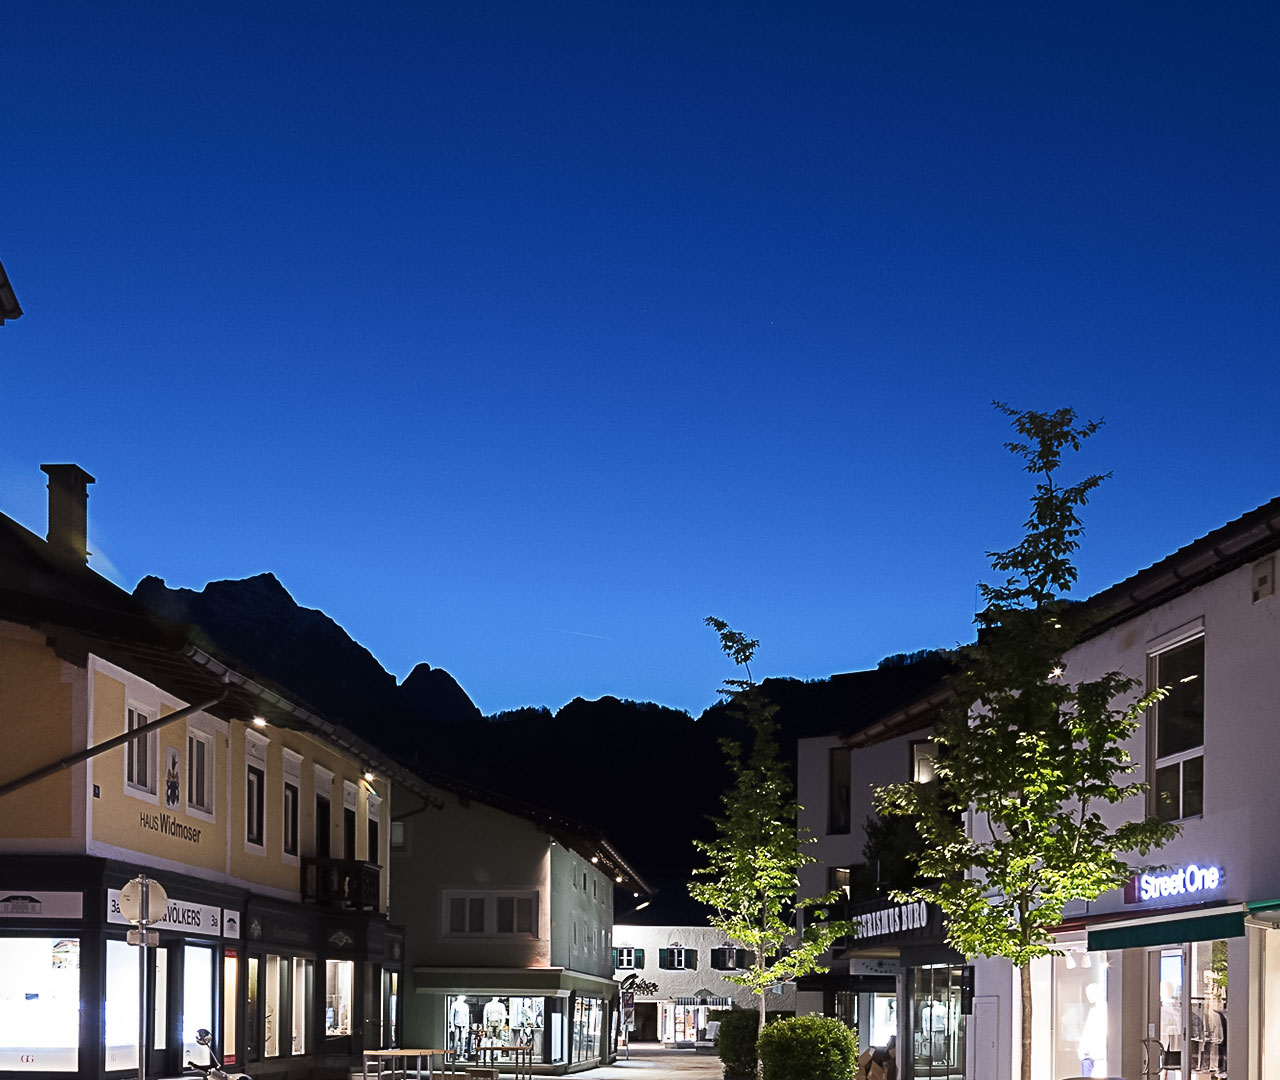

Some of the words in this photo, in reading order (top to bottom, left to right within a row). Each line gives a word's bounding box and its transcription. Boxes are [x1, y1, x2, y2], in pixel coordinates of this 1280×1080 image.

[140, 812, 159, 832] HAUS
[160, 813, 201, 844] Widmoser
[1141, 868, 1186, 900] Street
[1185, 864, 1220, 893] One
[211, 915, 218, 927] 3a
